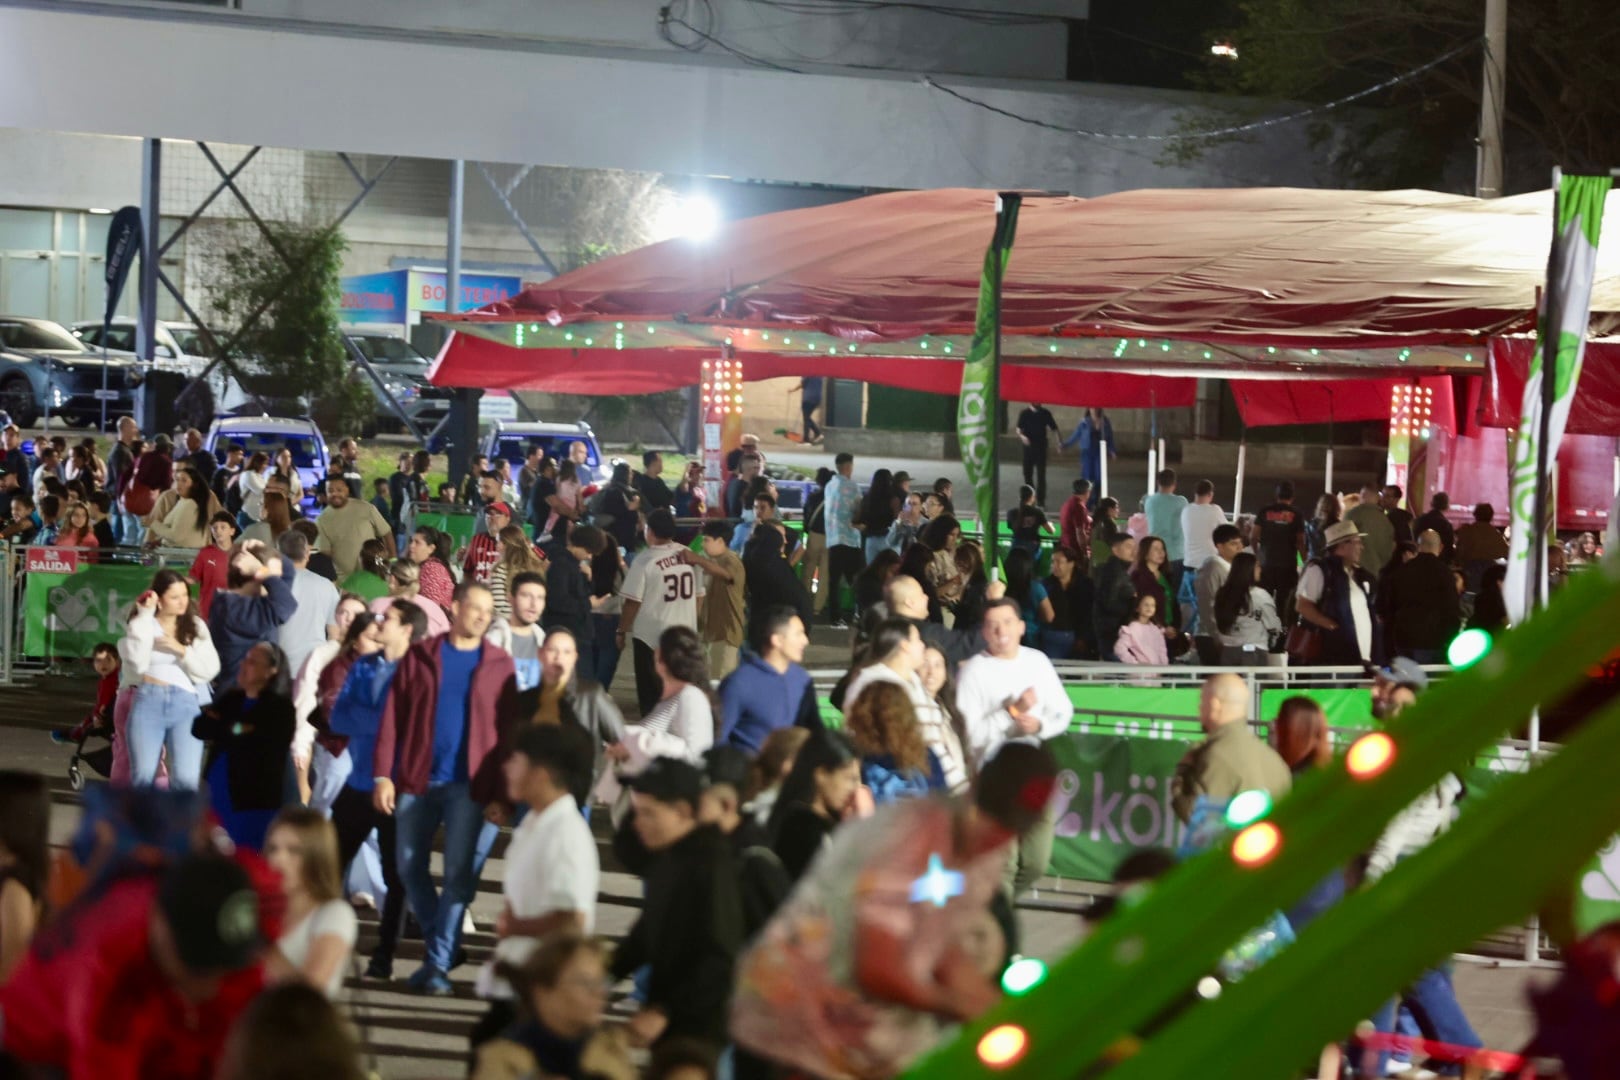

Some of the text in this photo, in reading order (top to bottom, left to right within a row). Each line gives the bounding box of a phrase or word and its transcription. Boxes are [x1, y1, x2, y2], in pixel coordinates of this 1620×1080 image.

[421, 283, 509, 304] BOTERÍA
[29, 560, 72, 572] SALIDA
[655, 552, 687, 570] TUCK
[663, 571, 693, 602] 30
[1089, 770, 1188, 849] köl
